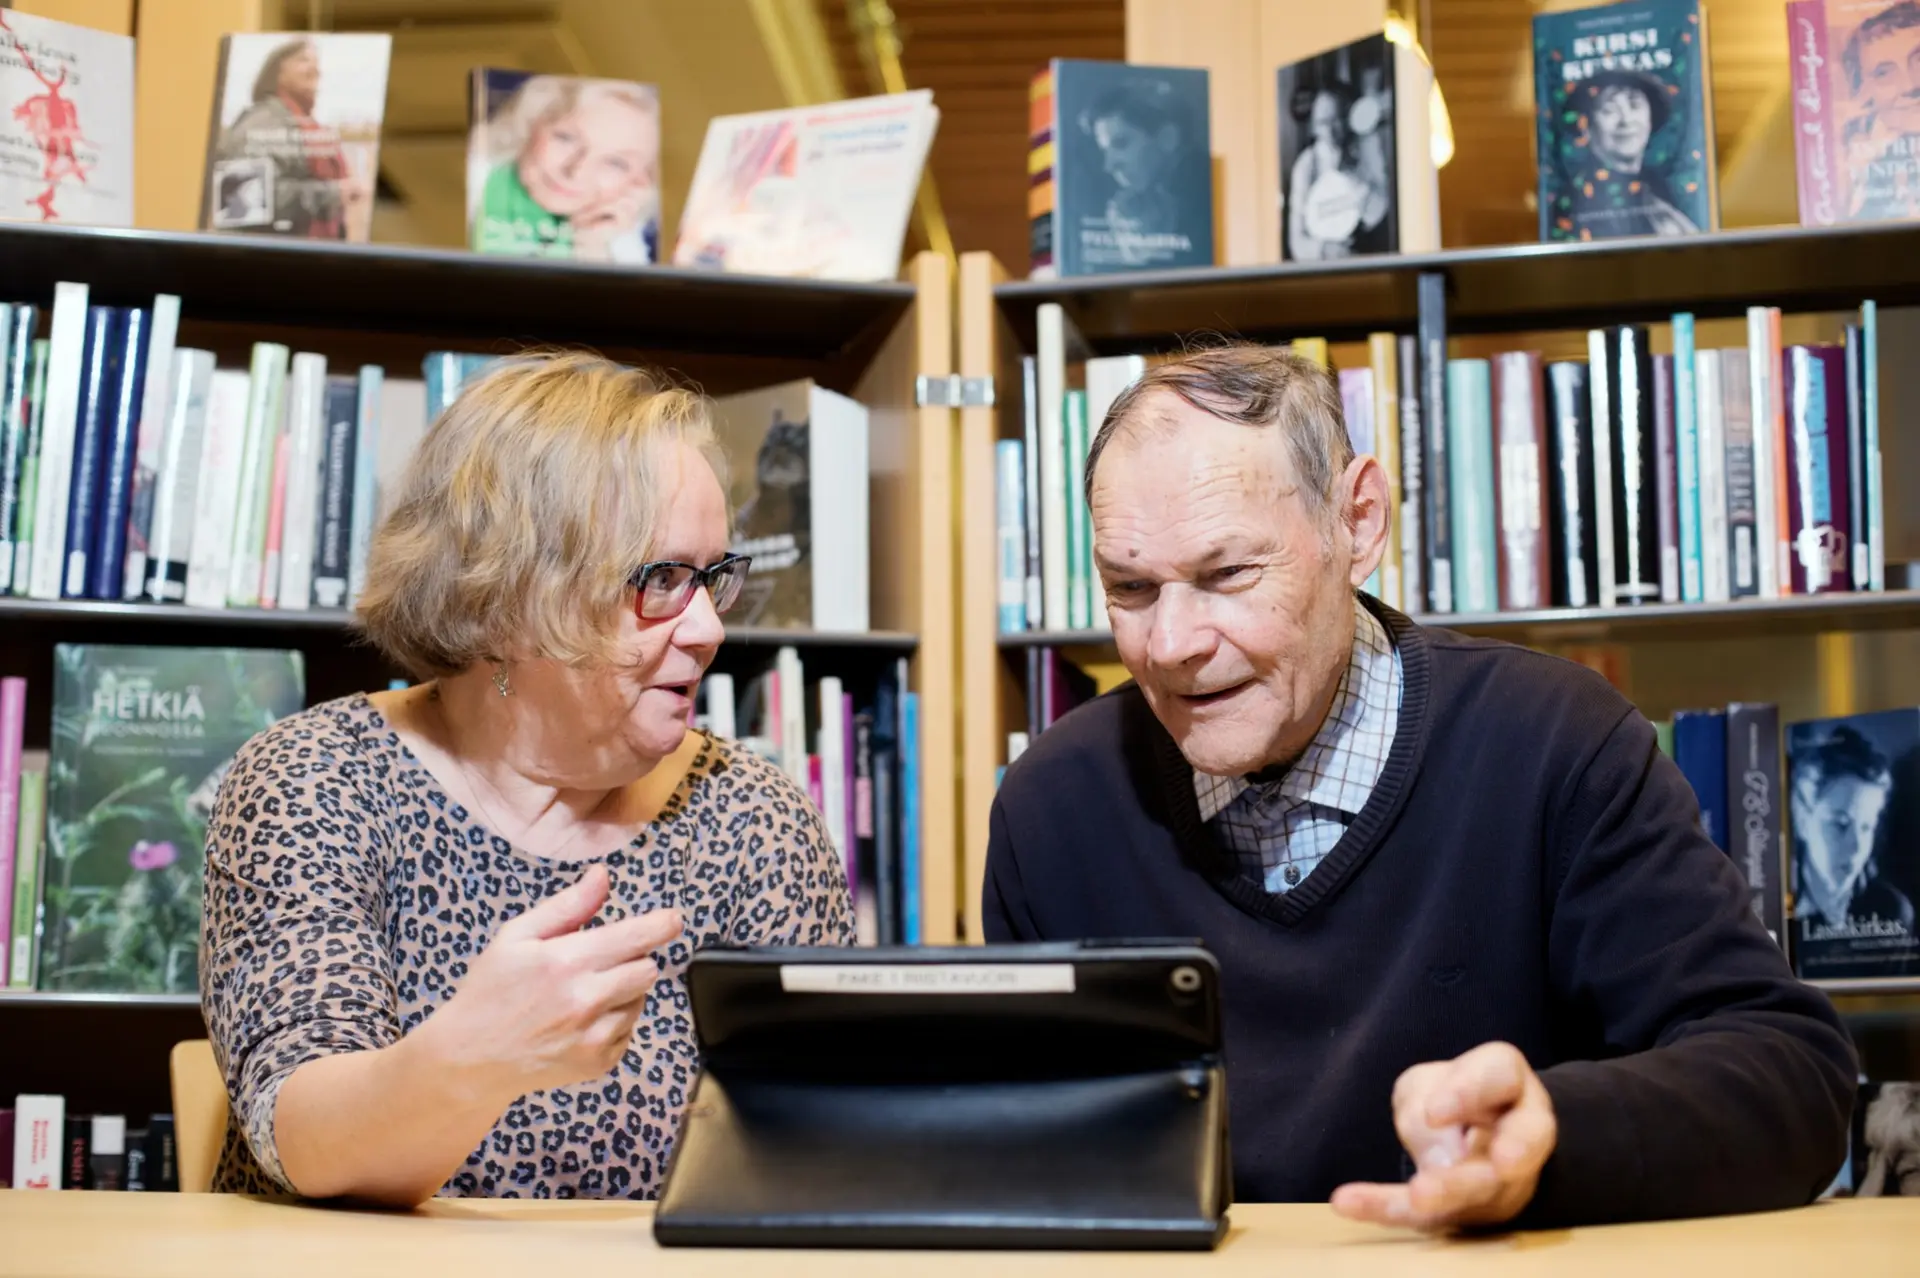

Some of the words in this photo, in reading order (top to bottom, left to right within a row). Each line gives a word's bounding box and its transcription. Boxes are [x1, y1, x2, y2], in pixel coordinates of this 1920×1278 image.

[1573, 27, 1658, 57] KIRSI
[92, 684, 205, 721] HETKIÄ
[94, 720, 206, 739] UONNOSSA
